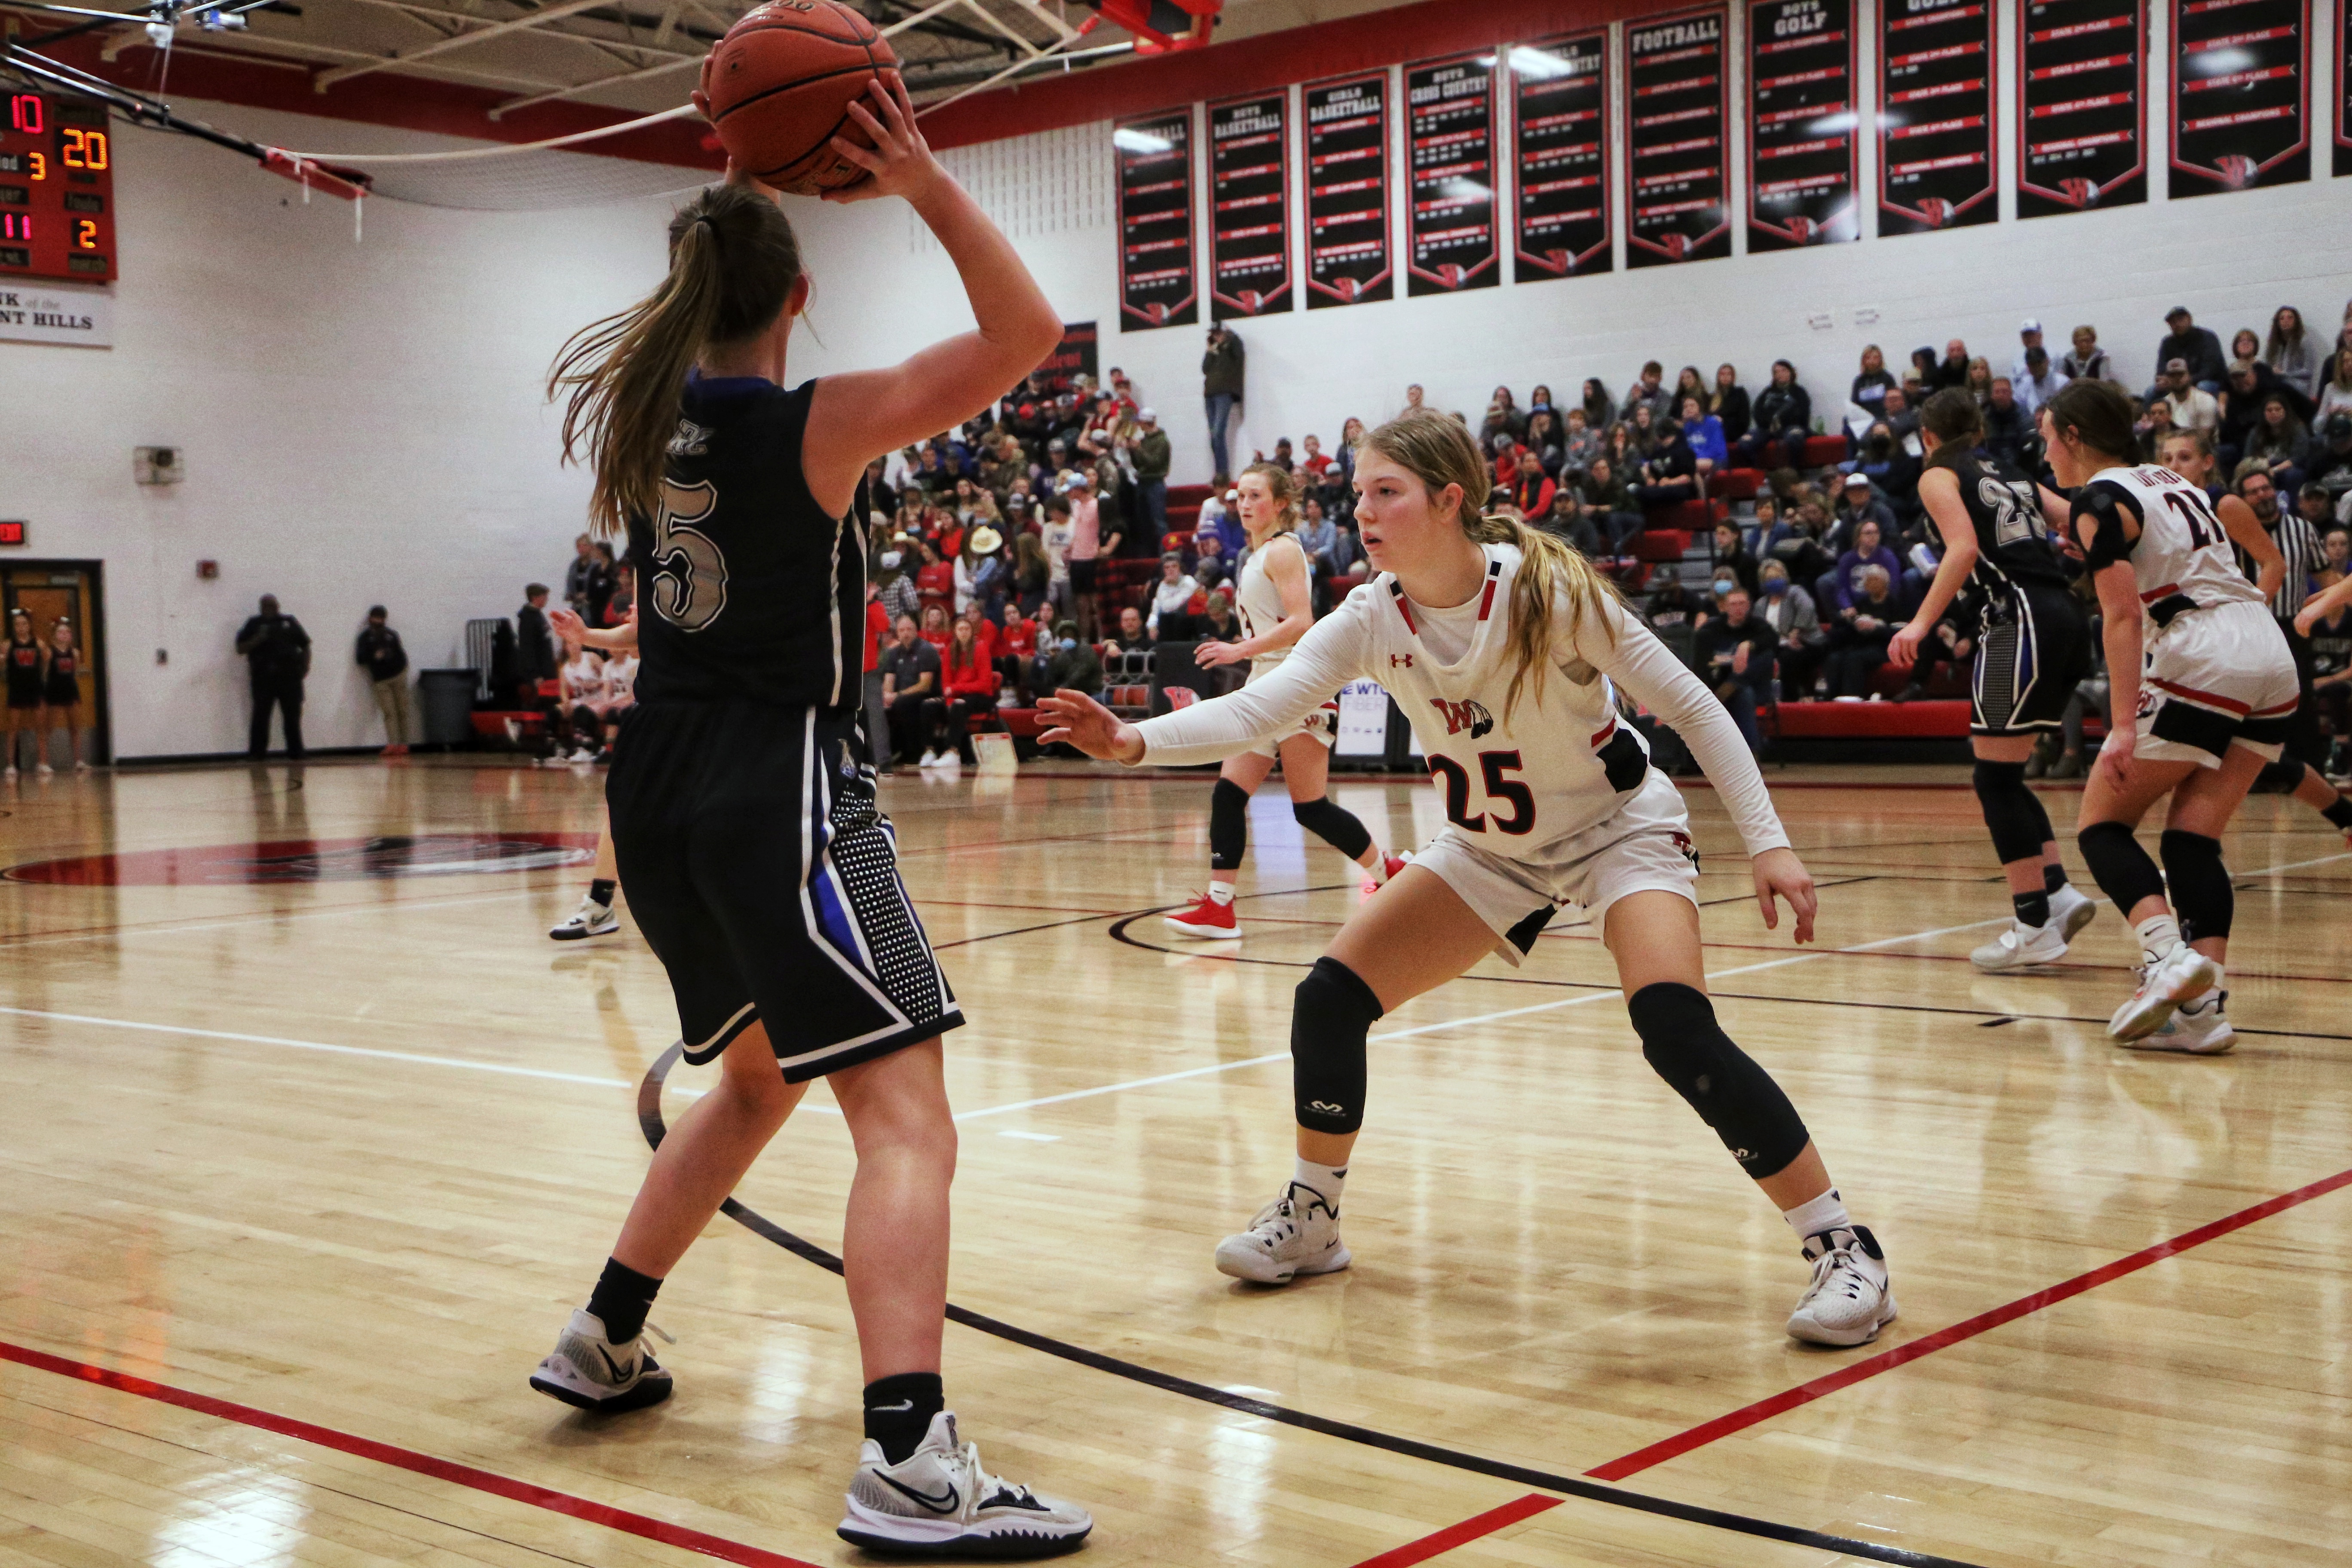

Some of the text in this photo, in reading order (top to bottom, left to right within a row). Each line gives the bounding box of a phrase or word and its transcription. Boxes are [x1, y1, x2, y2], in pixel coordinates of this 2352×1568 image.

[1782, 0, 1820, 17] BOYS
[1632, 19, 1719, 53] FOOTBALL
[1774, 11, 1827, 36] GOLF
[12, 95, 44, 134] 10
[1310, 95, 1381, 122] BASKETBALL
[1215, 113, 1280, 138] BASKETBALL
[63, 129, 107, 170] 20
[28, 152, 46, 180] 3
[5, 213, 31, 240] 11
[80, 220, 97, 248] 2
[0, 292, 19, 306] K
[33, 312, 93, 330] HILLS
[2163, 490, 2225, 551] 21
[652, 476, 728, 632] 5
[1428, 749, 1536, 835] 25
